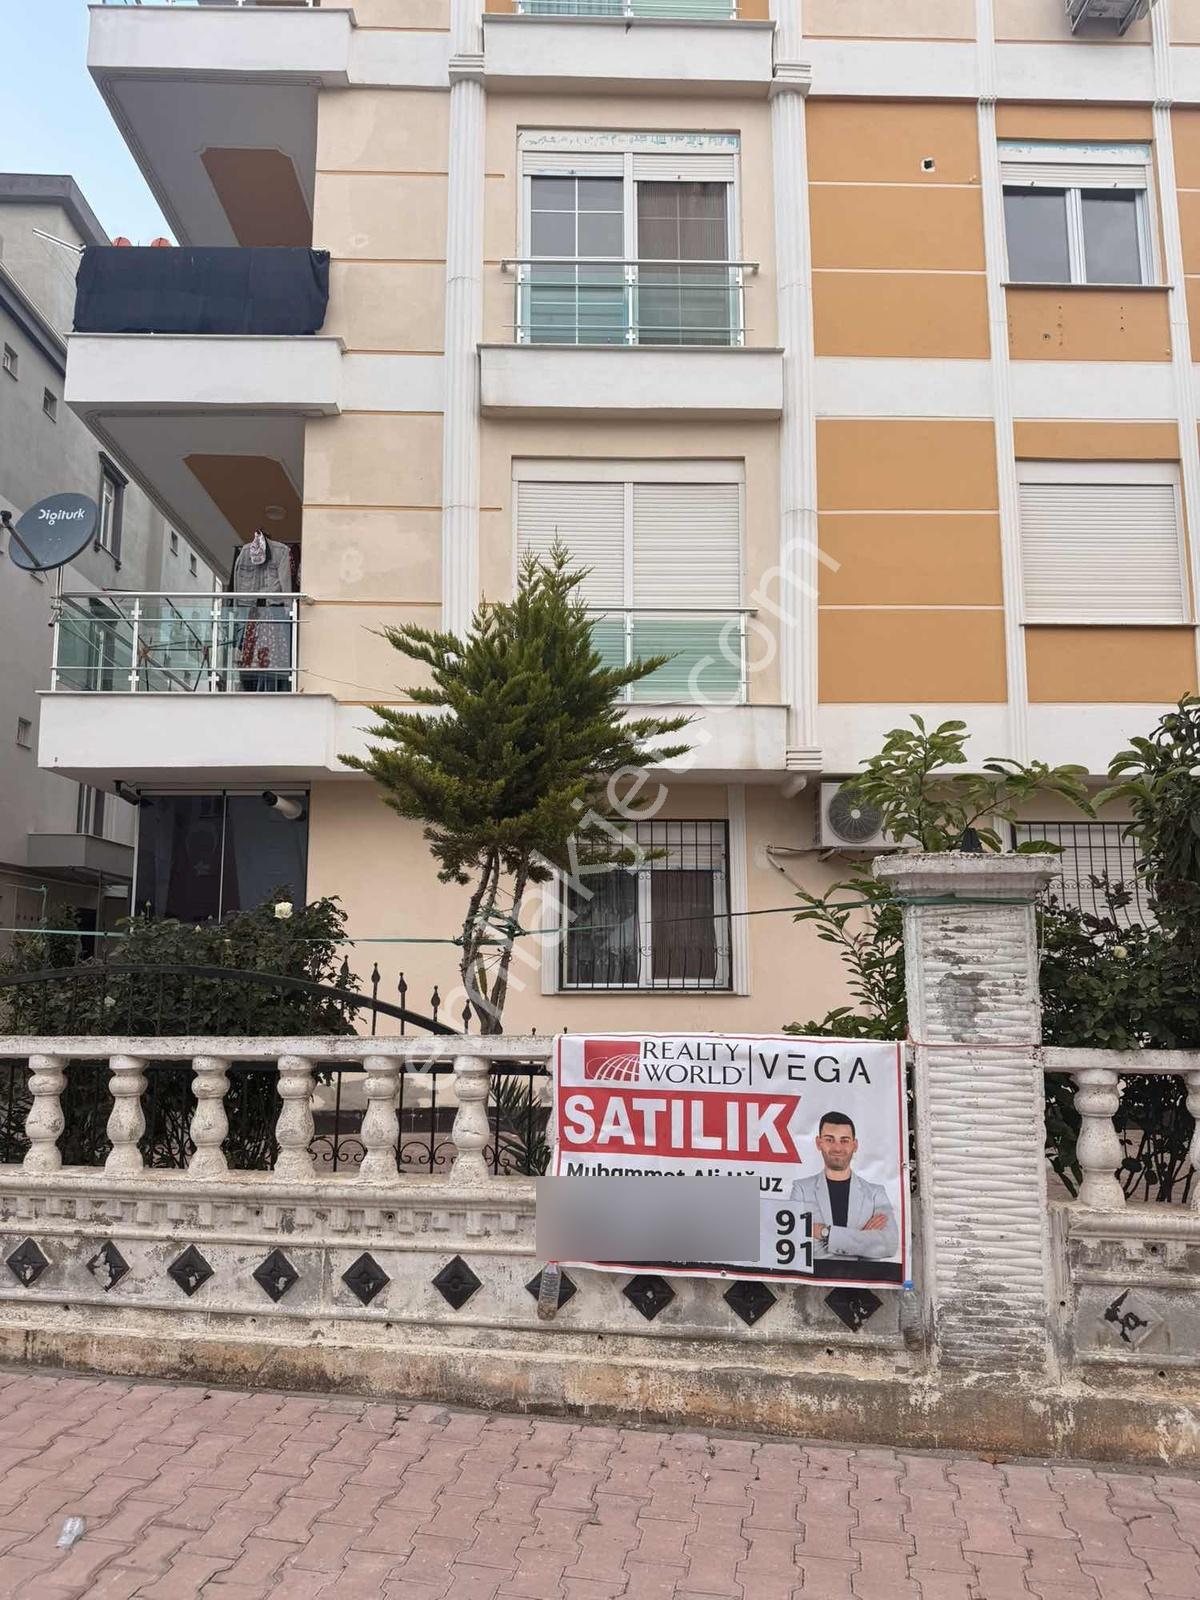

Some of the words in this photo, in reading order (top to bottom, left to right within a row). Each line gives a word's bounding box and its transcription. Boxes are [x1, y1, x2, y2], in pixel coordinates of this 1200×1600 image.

[38, 508, 85, 525] Digiturk
[643, 1041, 739, 1062] REALTY
[759, 1053, 871, 1084] VEGA
[563, 1094, 788, 1155] SATILIK
[775, 1209, 813, 1238] 91
[775, 1239, 813, 1267] 91
